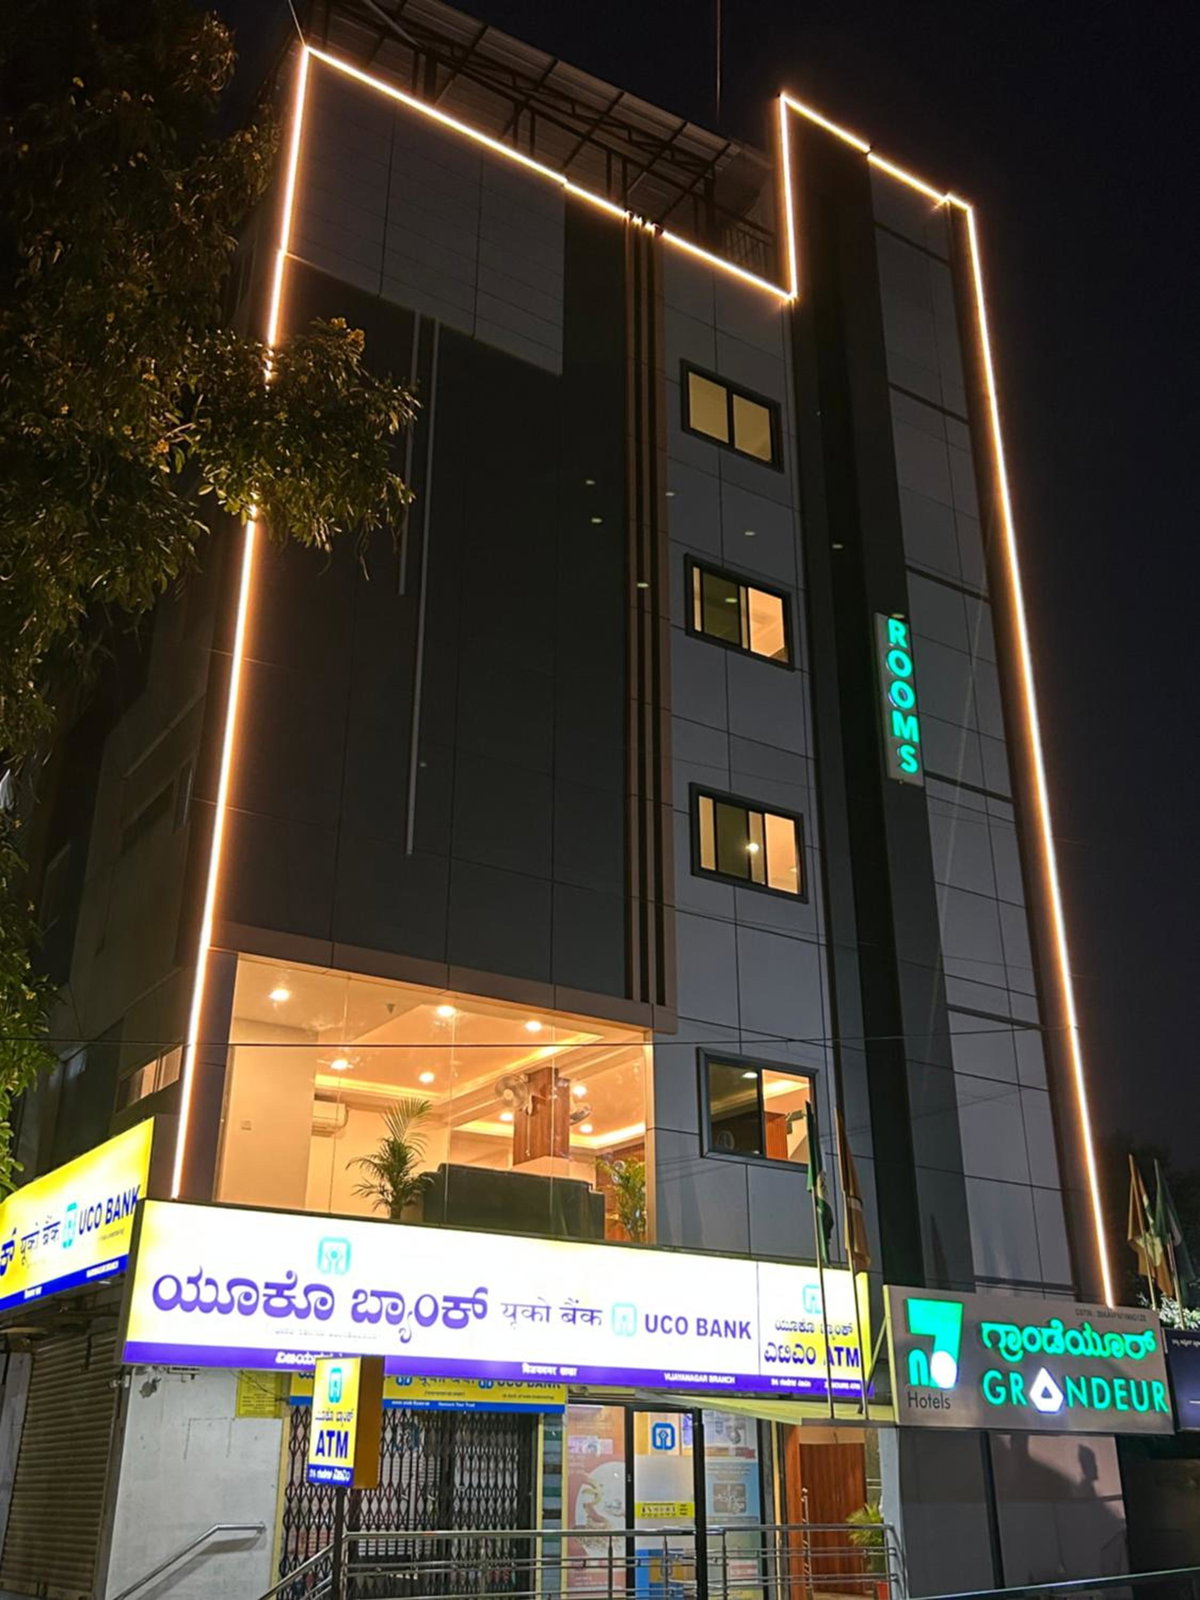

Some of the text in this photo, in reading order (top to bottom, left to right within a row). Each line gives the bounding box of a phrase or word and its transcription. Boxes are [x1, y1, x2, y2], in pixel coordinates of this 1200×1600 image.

[886, 617, 920, 775] ROOMS
[79, 1184, 141, 1235] UCO BANK
[152, 1265, 489, 1344] ಯೂಕೊ ಬ್ಯಾಂಕ್
[559, 1297, 603, 1326] बैंक
[645, 1313, 752, 1340] UCO BANK
[824, 1346, 860, 1368] ATM
[907, 1392, 952, 1410] Hotels
[982, 1367, 1169, 1413] GRANDEUR
[315, 1430, 349, 1459] ATM
